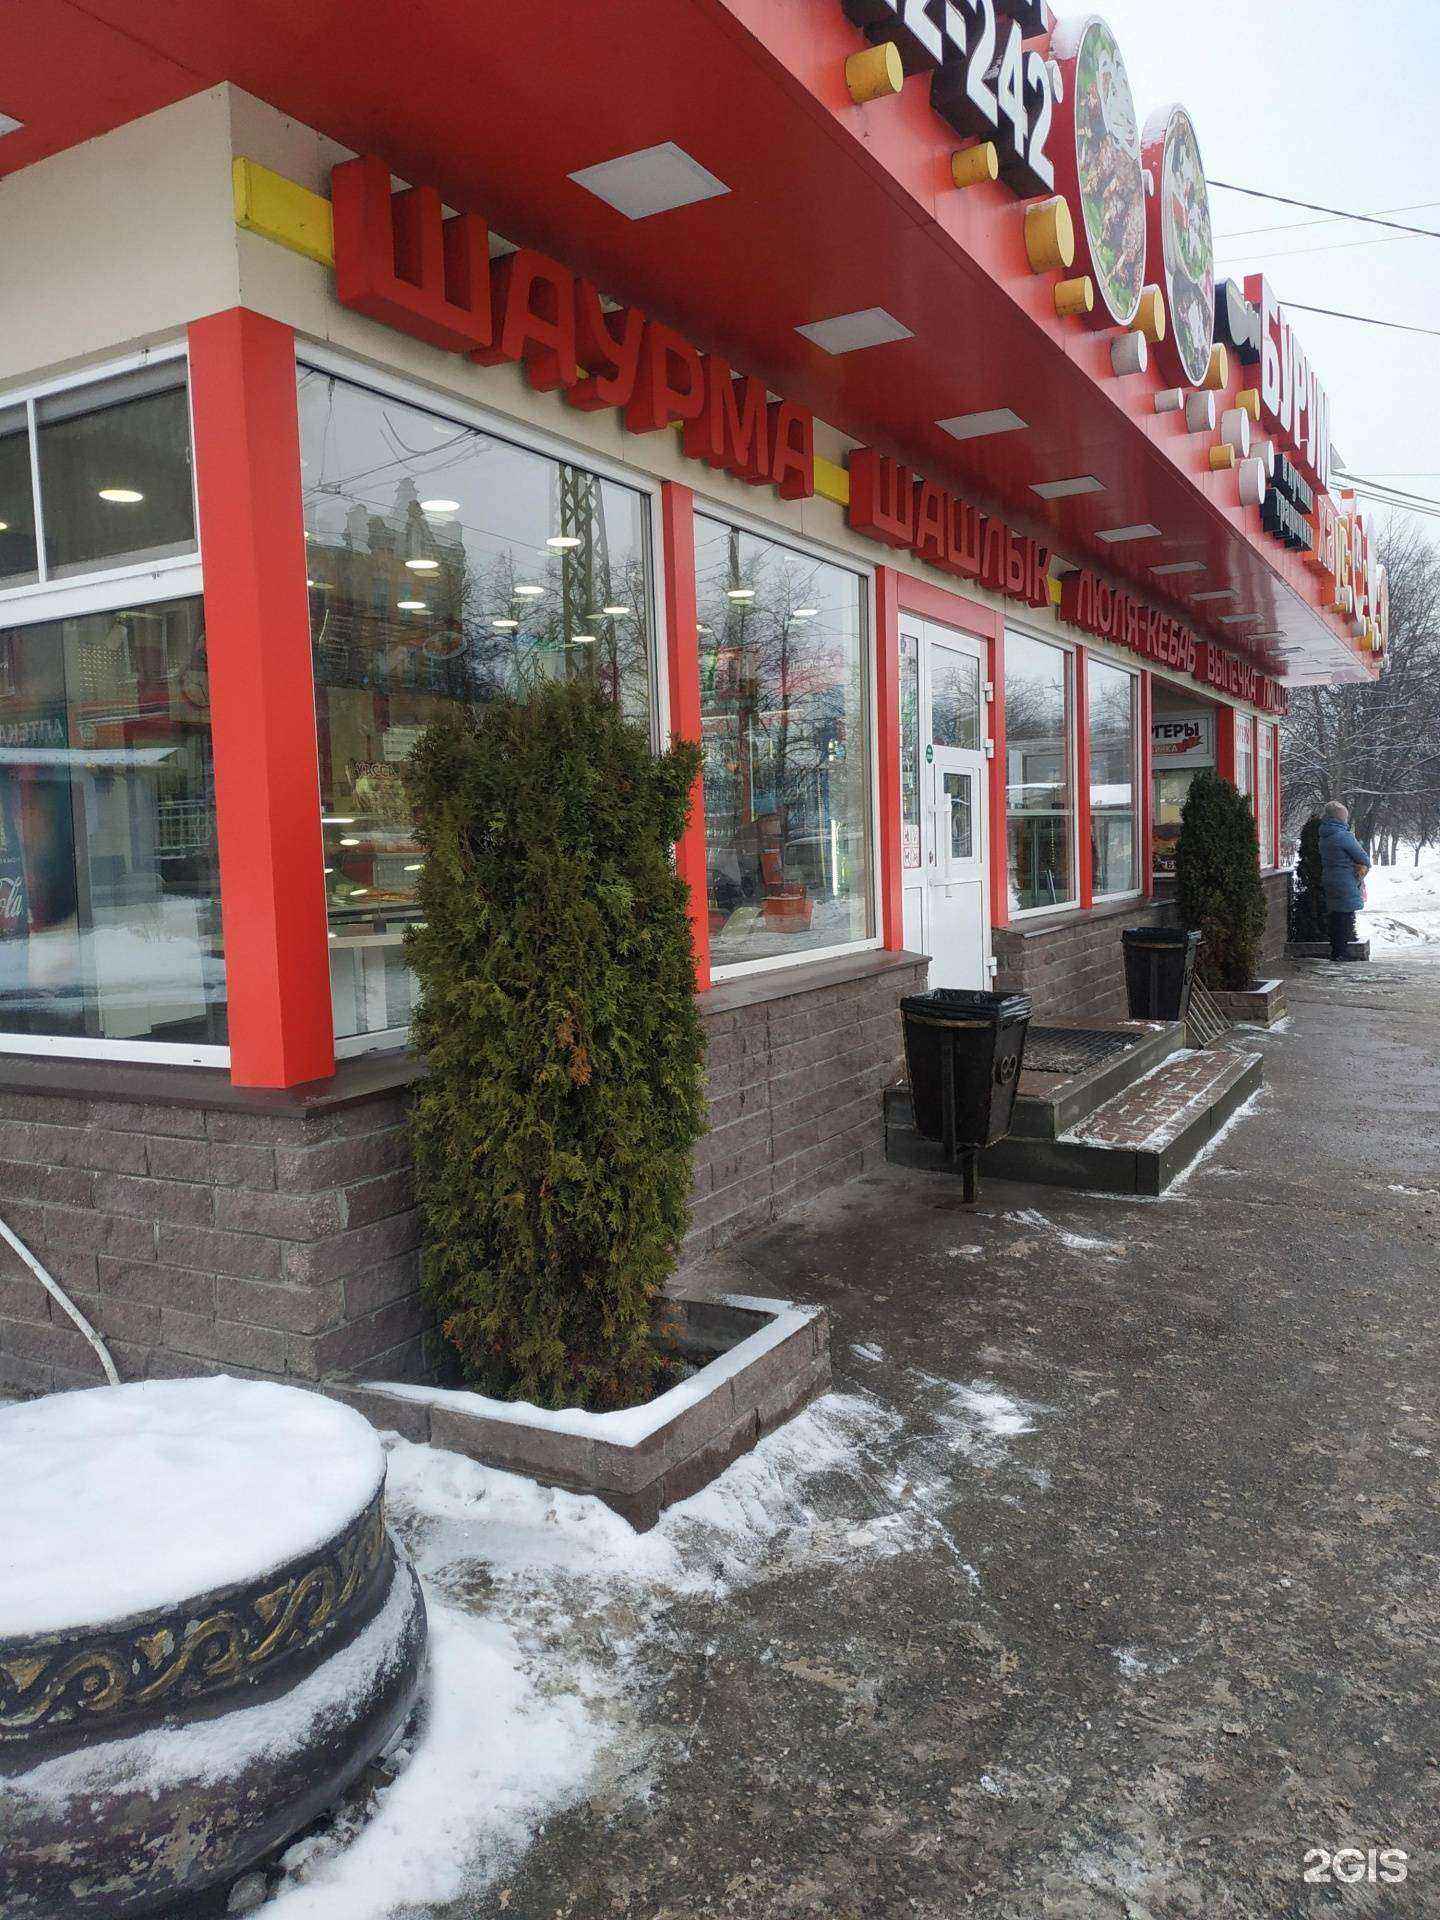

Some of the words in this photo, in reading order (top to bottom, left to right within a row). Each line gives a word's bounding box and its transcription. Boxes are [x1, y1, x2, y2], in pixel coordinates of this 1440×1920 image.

[340, 155, 814, 499] ШАУРМА
[868, 453, 1051, 606] ШАШЛЫК
[1152, 722, 1199, 739] ГЕРЫ
